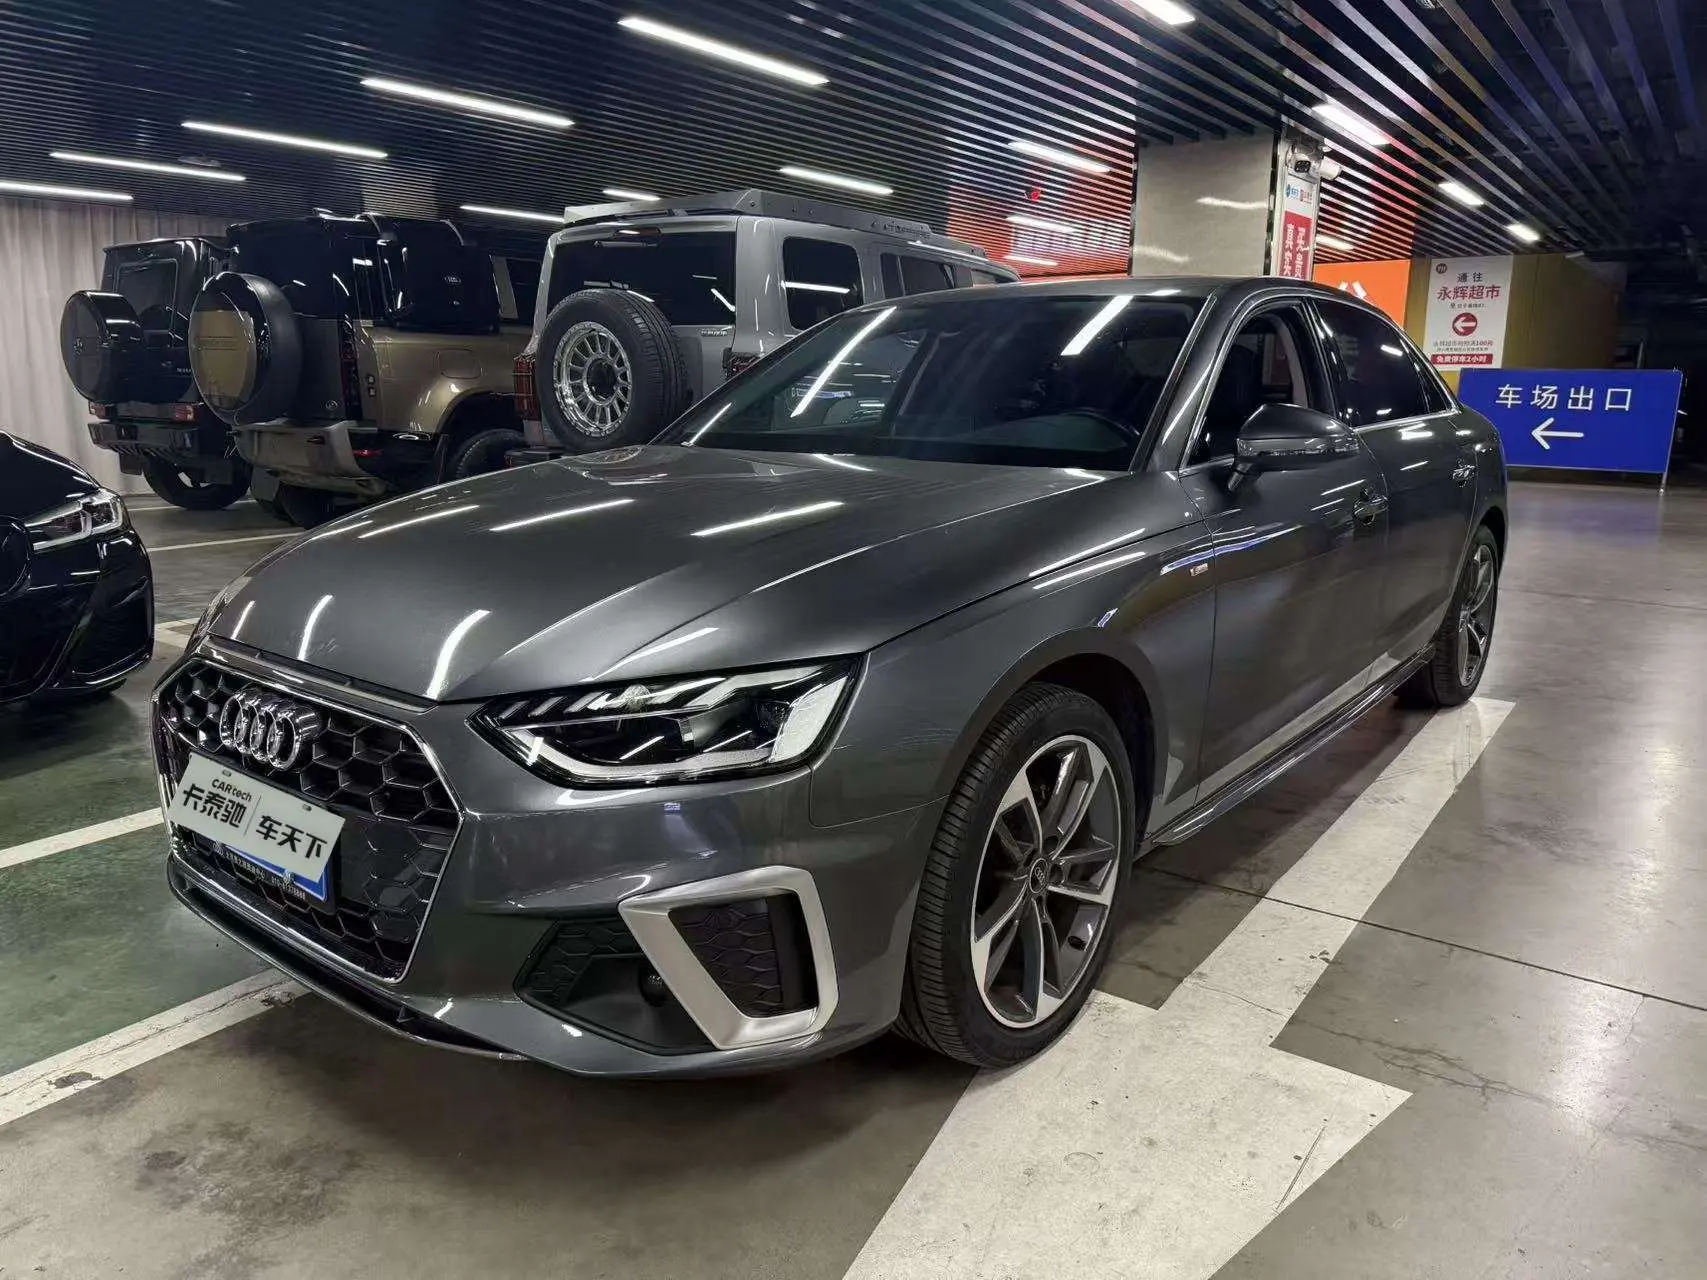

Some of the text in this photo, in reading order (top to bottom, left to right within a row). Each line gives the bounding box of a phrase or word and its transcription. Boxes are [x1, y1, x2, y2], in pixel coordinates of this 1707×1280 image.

[1457, 272, 1483, 282] 通往
[1437, 285, 1501, 301] 永辉超市
[1495, 384, 1632, 411] 车场出口
[211, 778, 252, 802] CARtech
[182, 783, 247, 828] 卡泰驰
[255, 815, 328, 859] 车天下
